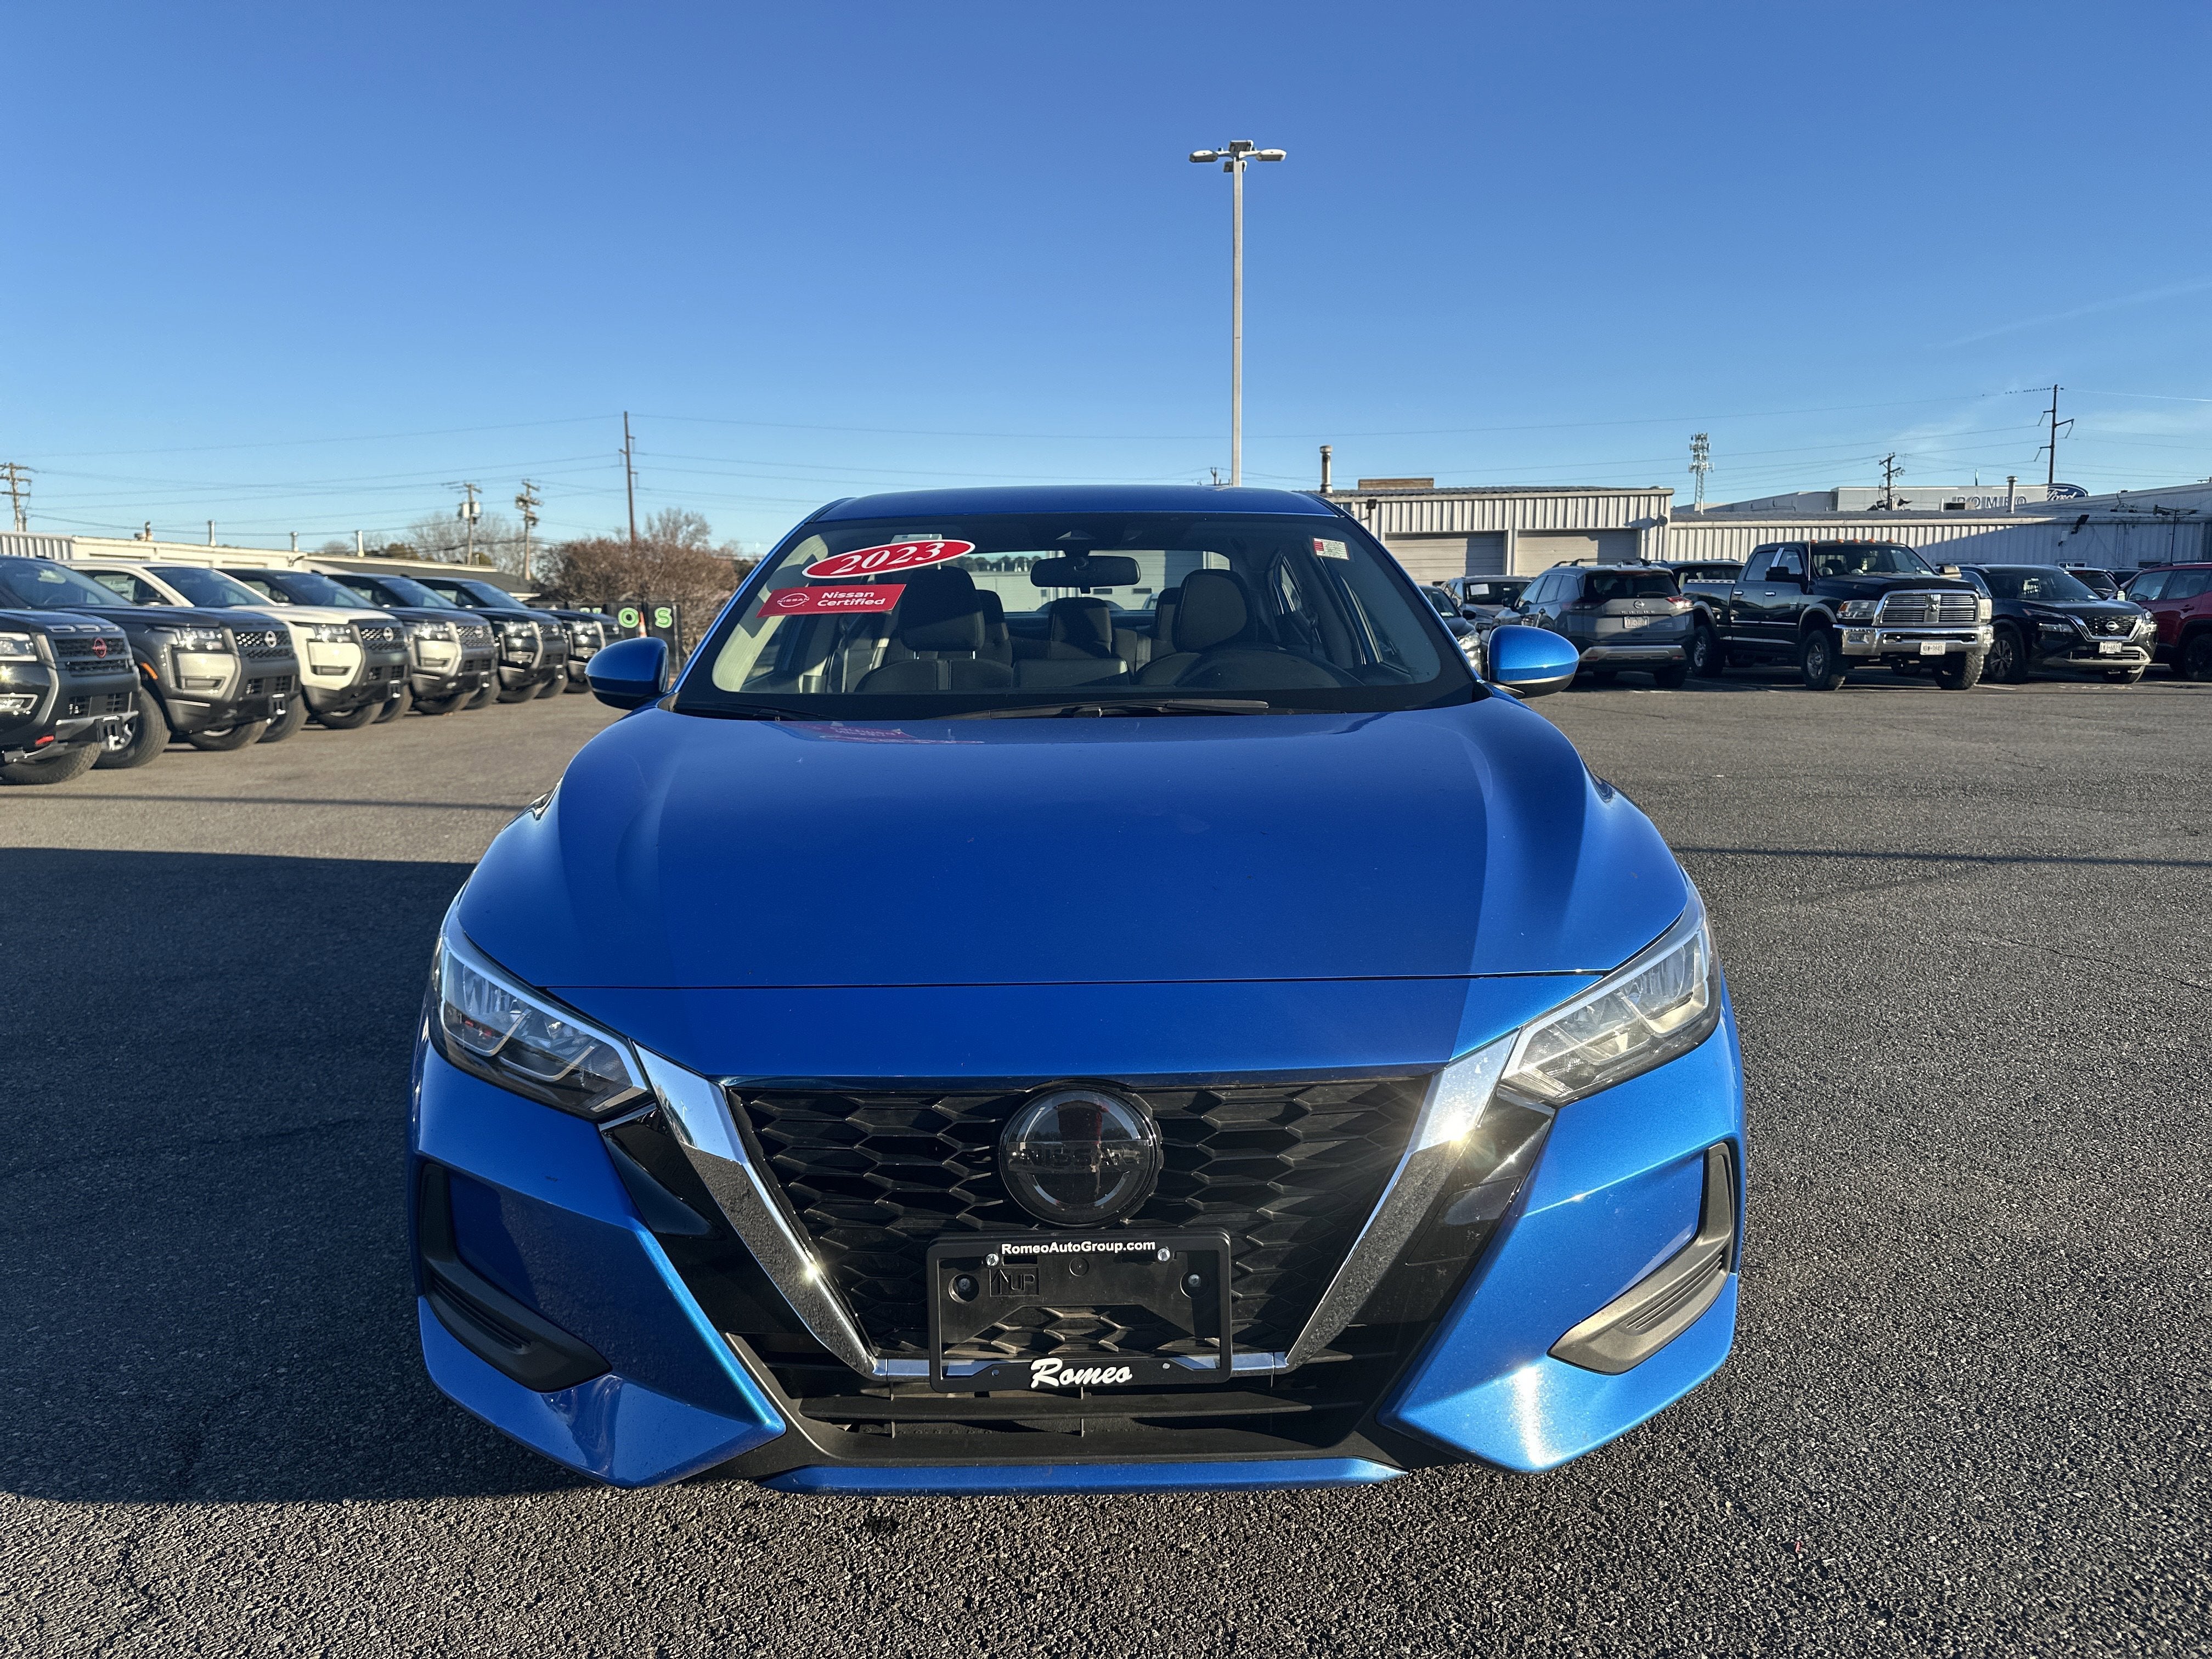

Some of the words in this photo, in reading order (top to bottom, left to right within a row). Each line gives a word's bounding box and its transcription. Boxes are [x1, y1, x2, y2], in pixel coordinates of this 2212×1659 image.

[2047, 487, 2078, 501] Ford
[830, 542, 945, 575] 2023
[817, 598, 886, 606] Certified
[1001, 1241, 1155, 1254] RomeoAutoGroup.com
[1011, 1274, 1036, 1290] UP
[1030, 1357, 1133, 1389] Romeo
